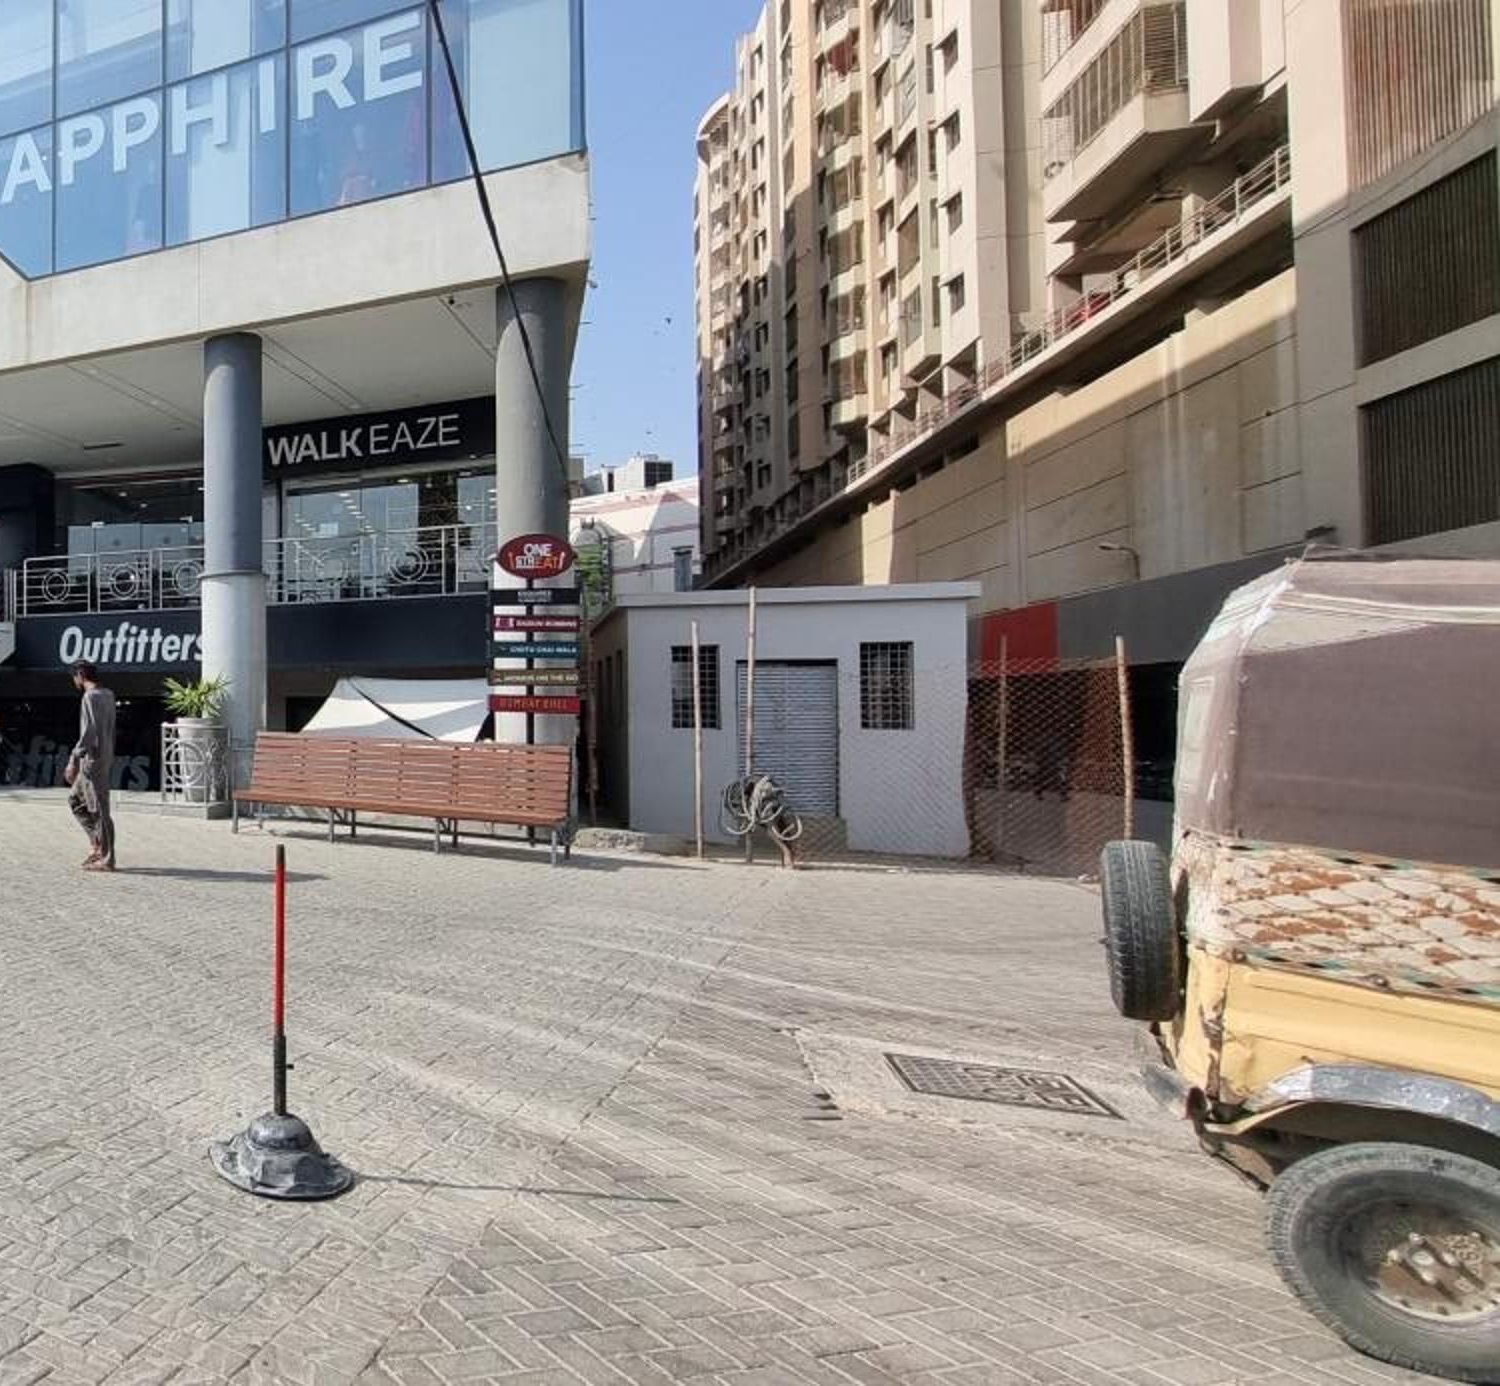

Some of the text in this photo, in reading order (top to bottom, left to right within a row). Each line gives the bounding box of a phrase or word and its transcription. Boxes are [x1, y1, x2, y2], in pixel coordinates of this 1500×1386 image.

[267, 413, 461, 466] WALK EAZE
[524, 543, 553, 556] ONE
